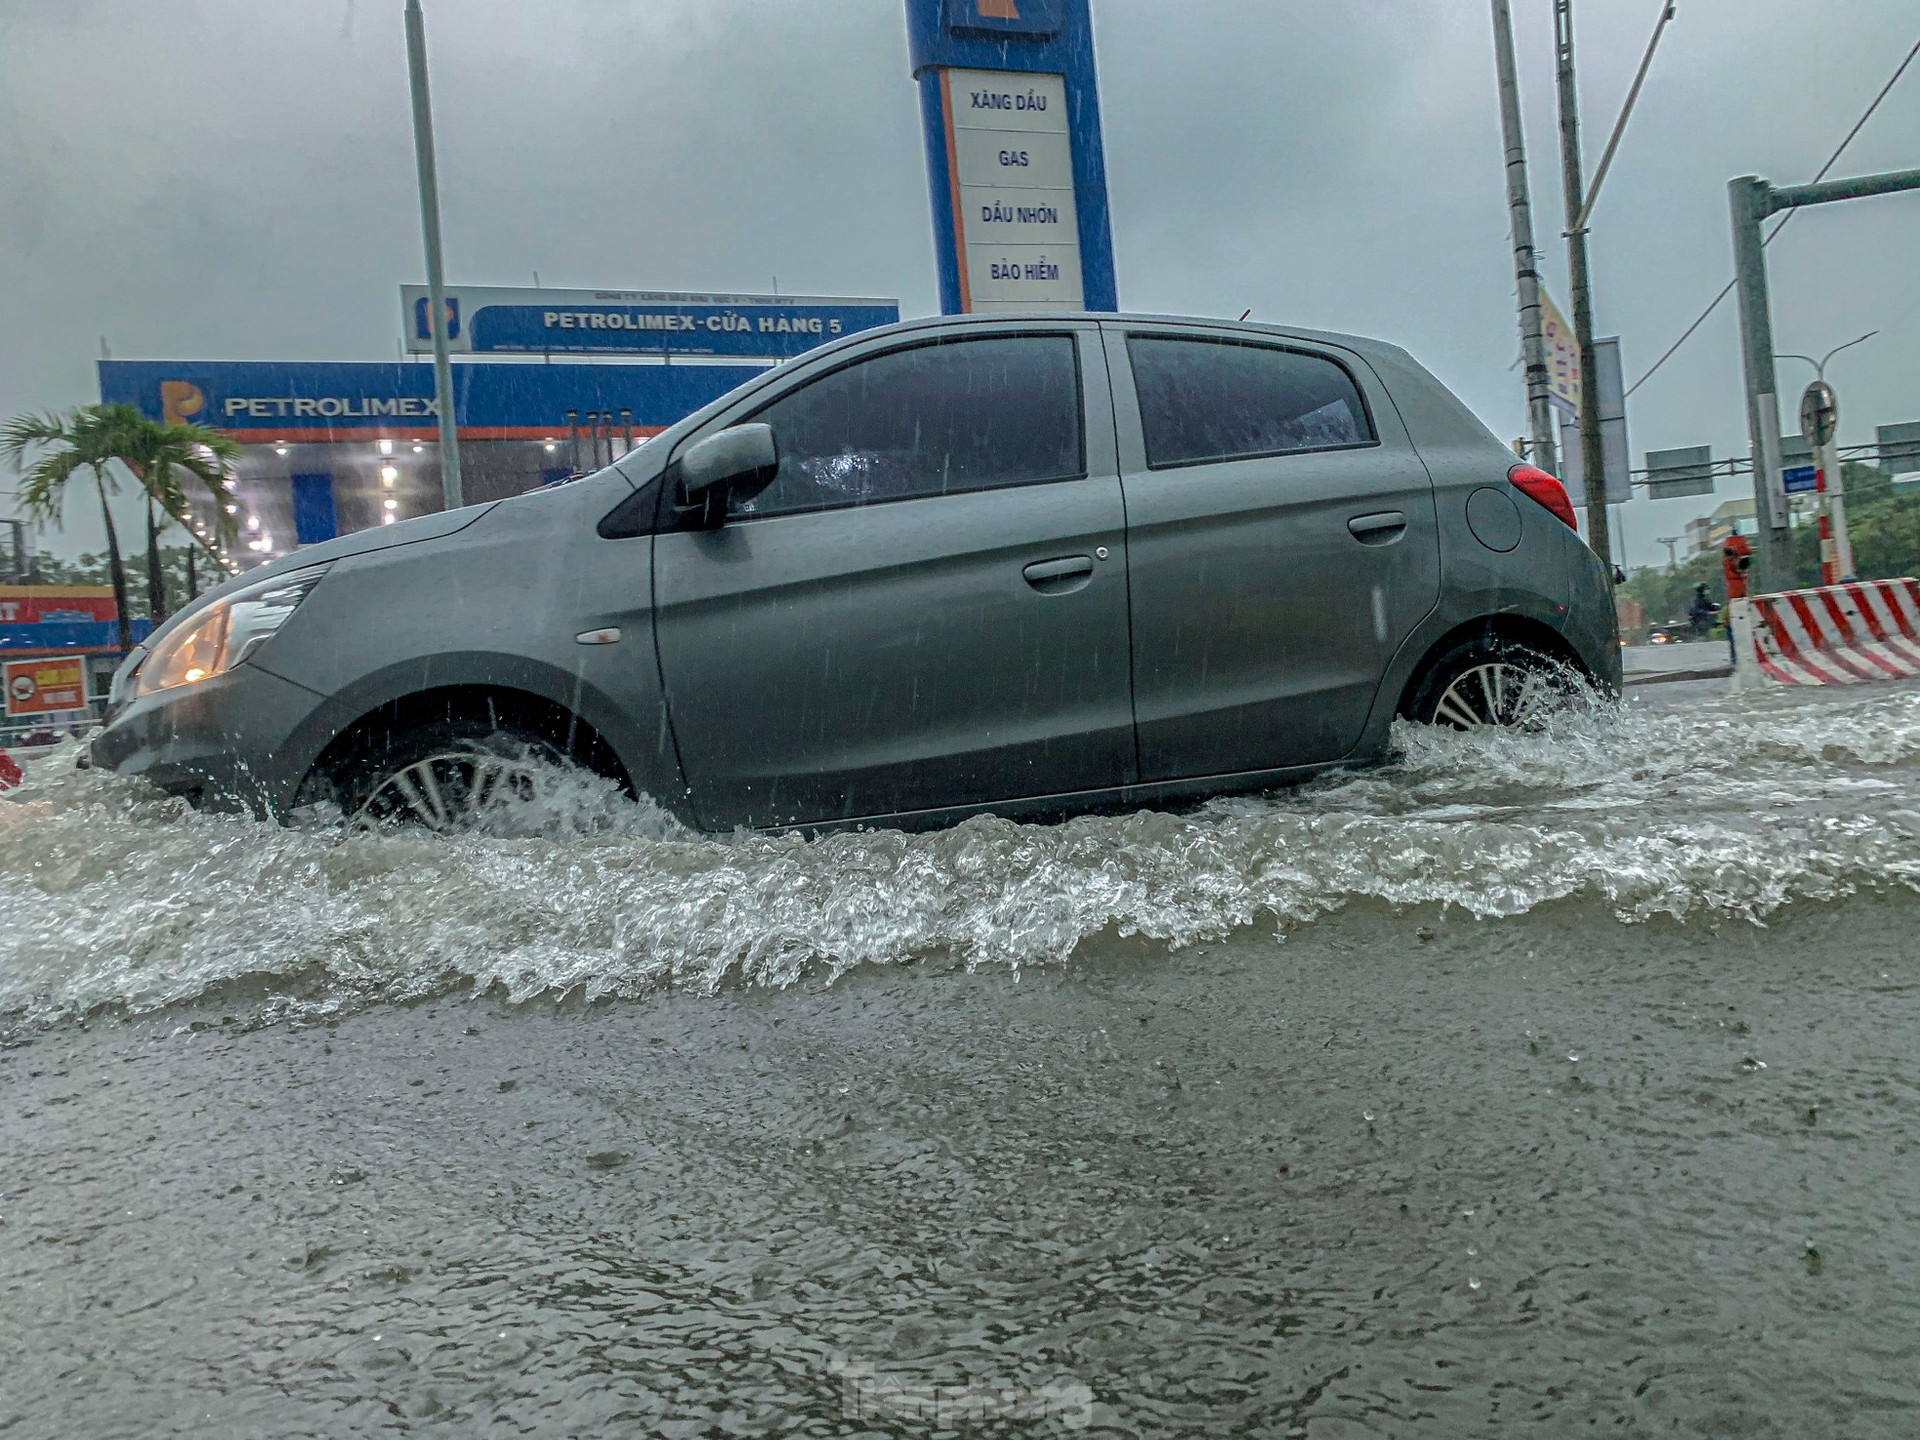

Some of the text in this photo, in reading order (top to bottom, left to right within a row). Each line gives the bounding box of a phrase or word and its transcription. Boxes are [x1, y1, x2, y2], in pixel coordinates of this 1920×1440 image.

[999, 150, 1029, 166] GAS
[758, 313, 822, 333] HÀNG
[829, 318, 842, 333] 5
[225, 397, 440, 417] PETROLIMEX
